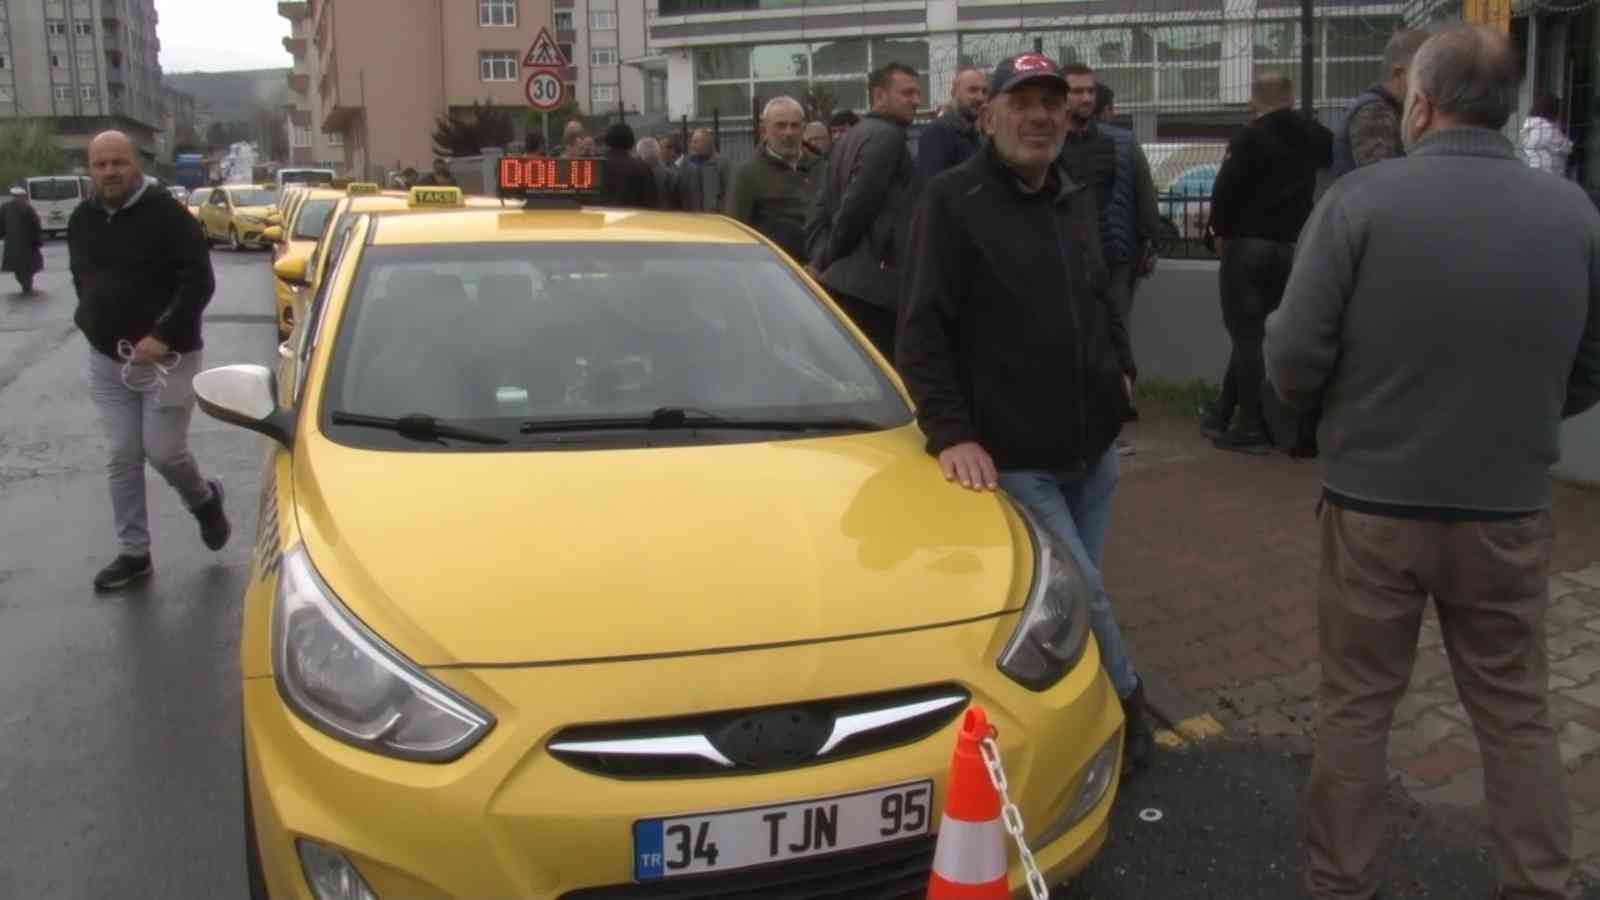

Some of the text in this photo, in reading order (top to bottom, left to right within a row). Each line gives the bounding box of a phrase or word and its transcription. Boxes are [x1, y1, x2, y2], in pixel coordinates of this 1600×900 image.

[534, 79, 556, 99] 30
[501, 159, 592, 188] DOLU
[666, 788, 927, 869] 34 TJN 95
[641, 853, 661, 867] TR
